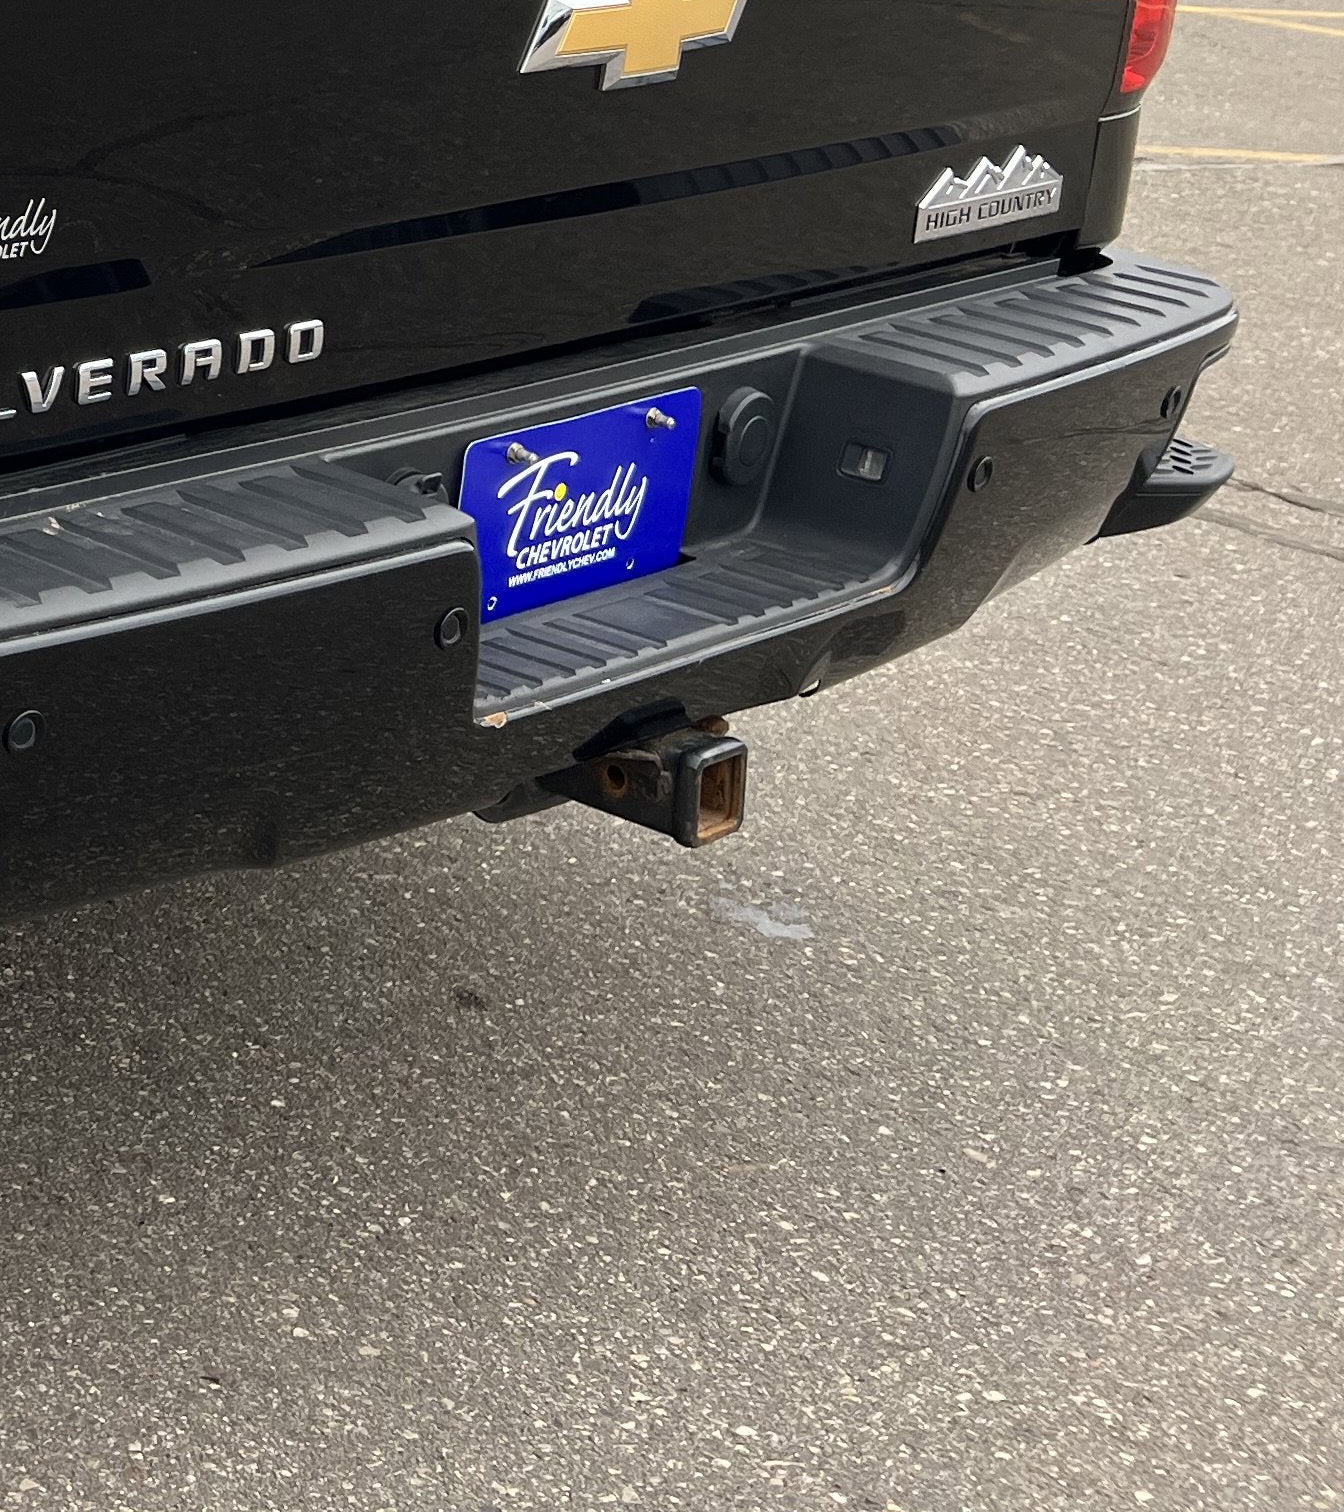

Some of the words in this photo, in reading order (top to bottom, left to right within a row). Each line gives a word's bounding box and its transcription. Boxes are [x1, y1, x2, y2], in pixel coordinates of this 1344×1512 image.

[925, 206, 972, 232] HIGH
[977, 187, 1057, 220] COUNTRY
[497, 451, 648, 557] Friendly
[508, 546, 616, 588] WWW.FRIENDLYCHEV.COM
[515, 522, 614, 570] CHEVROLET
